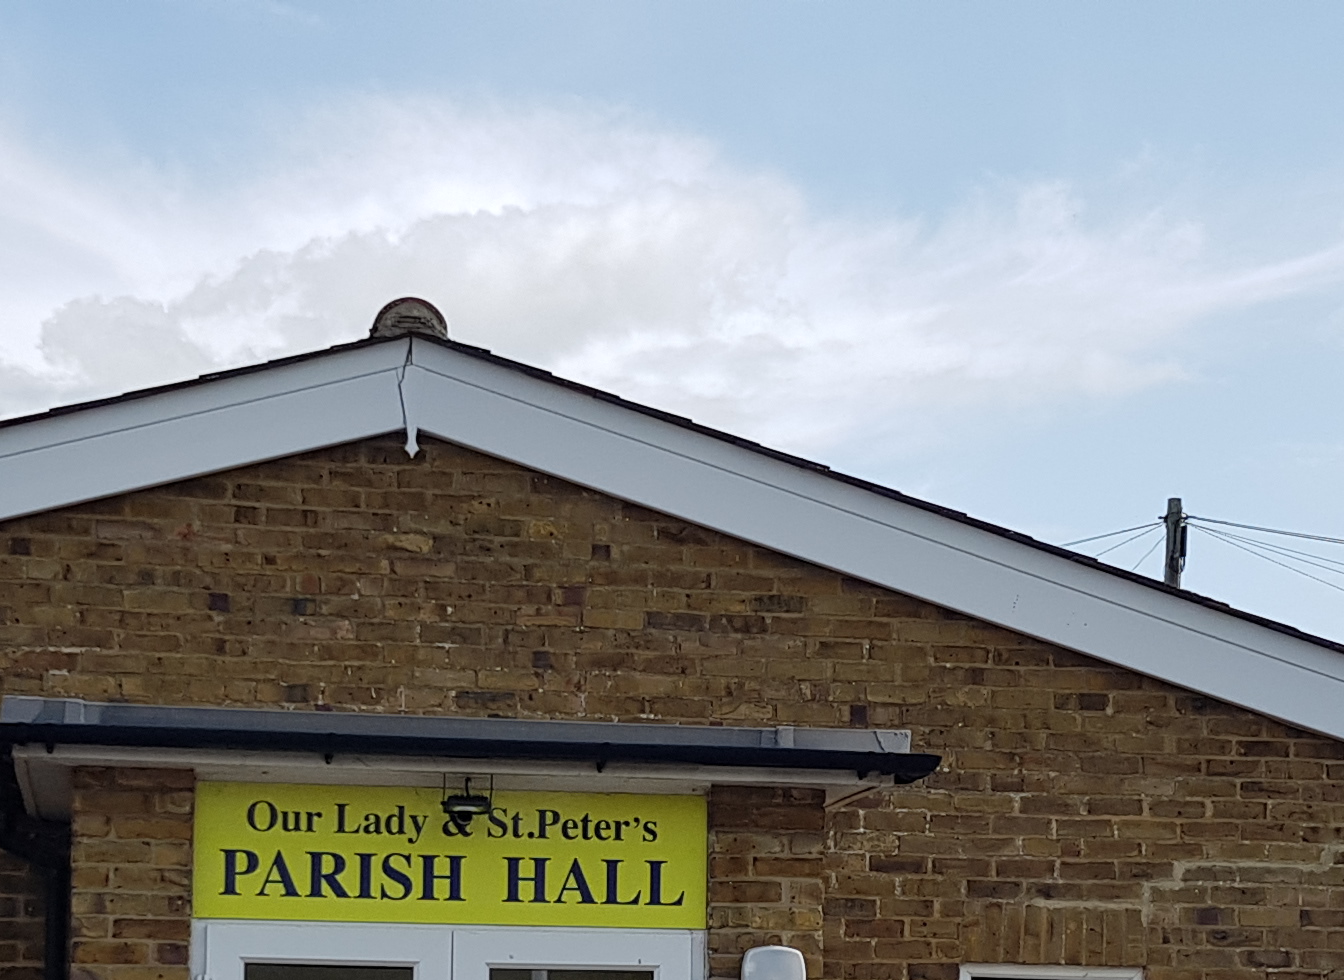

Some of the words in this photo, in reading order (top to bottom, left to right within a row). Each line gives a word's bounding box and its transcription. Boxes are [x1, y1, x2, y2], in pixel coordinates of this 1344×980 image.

[247, 800, 322, 833] Our
[334, 803, 428, 844] Lady
[219, 848, 467, 902] PARISH
[501, 857, 685, 906] HALL
